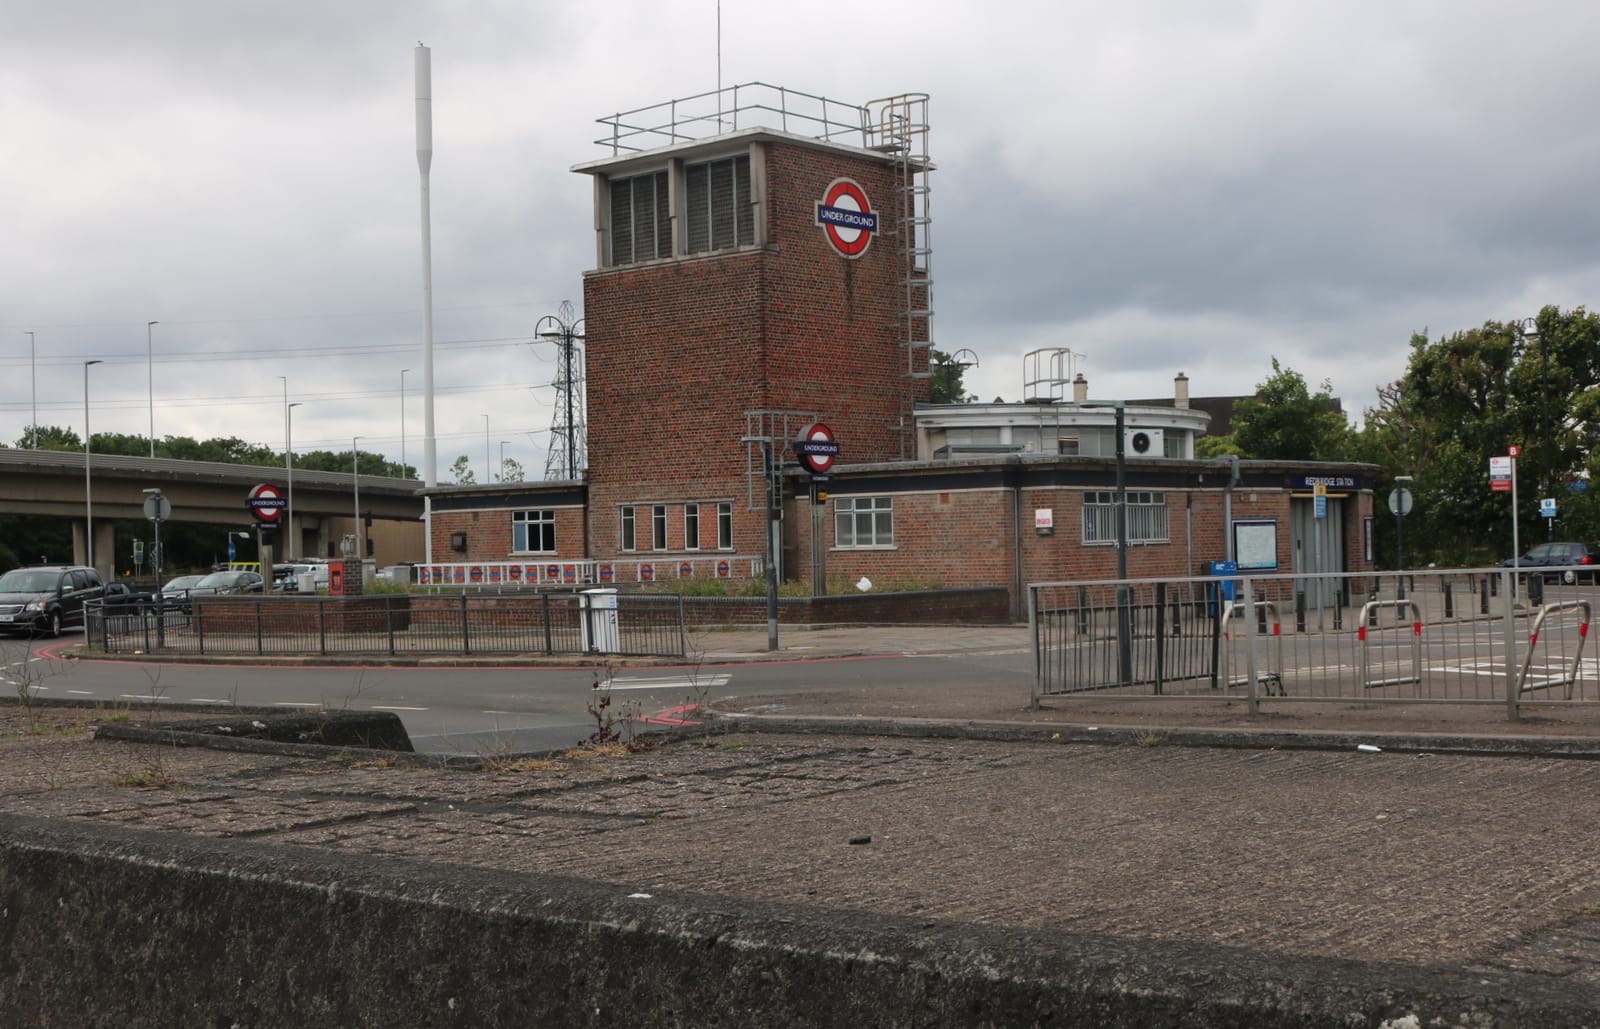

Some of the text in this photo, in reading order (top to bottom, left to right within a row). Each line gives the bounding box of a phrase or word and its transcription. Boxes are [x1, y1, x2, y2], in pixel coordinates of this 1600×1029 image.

[821, 208, 874, 227] UNDERGROUND
[804, 444, 838, 452] UNDERGROUND
[1336, 477, 1354, 487] STATION
